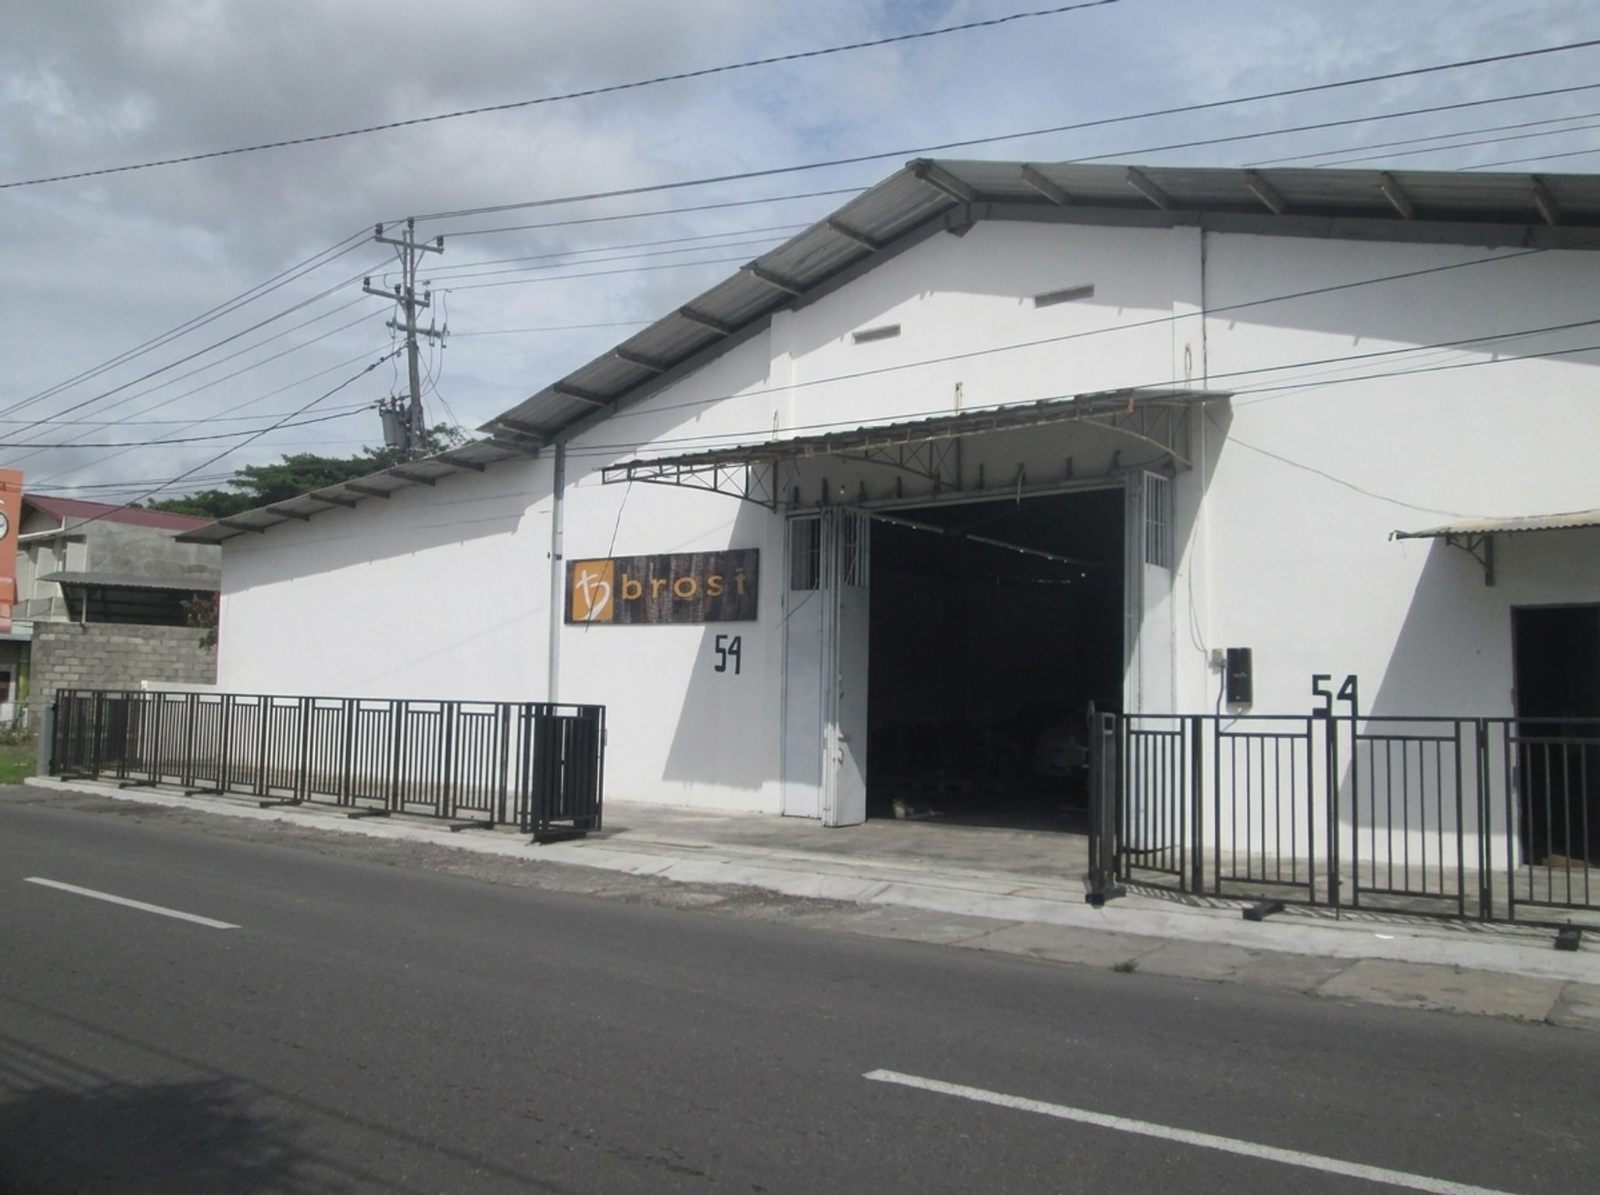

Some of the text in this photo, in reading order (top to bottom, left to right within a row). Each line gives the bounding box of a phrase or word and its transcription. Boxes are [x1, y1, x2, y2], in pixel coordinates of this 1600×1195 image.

[622, 567, 747, 600] brosi
[714, 634, 742, 675] 54
[1311, 674, 1358, 719] 54
